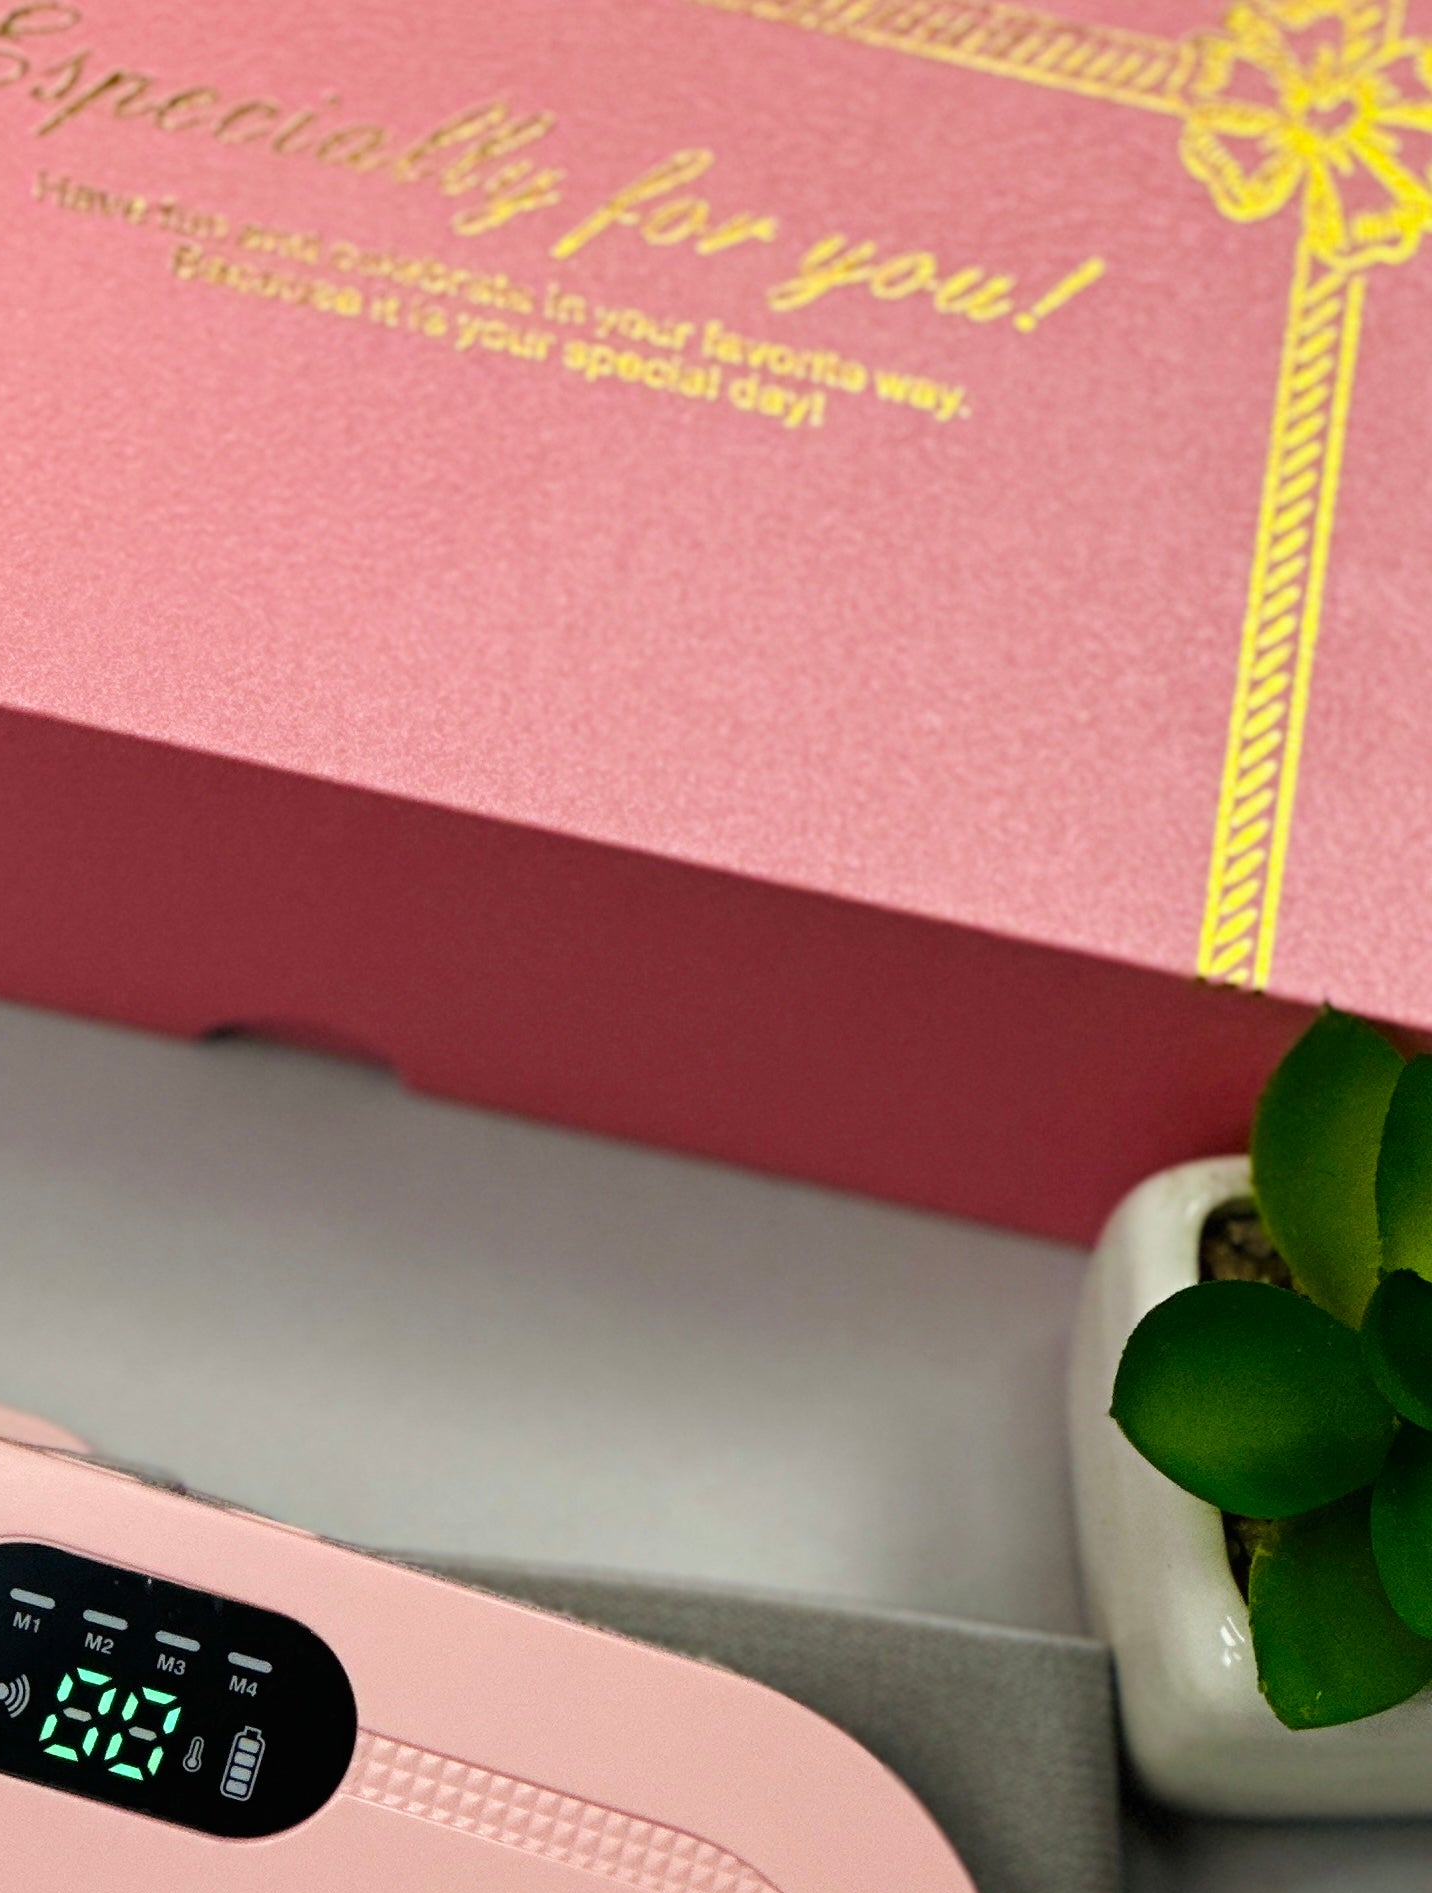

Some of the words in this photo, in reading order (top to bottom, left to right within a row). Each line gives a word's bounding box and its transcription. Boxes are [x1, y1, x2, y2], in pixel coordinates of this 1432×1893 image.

[548, 149, 778, 260] for
[770, 233, 1106, 333] you!
[369, 295, 402, 329] it
[408, 299, 449, 339] is
[453, 310, 558, 362] your
[562, 340, 723, 402] special
[728, 372, 829, 430] day!
[543, 281, 587, 326] in
[593, 303, 696, 351] your
[700, 320, 868, 394] favorite
[872, 368, 972, 423] way.
[12, 1611, 42, 1634] M1
[84, 1632, 115, 1656] M2
[156, 1653, 187, 1676] M3
[228, 1674, 259, 1697] M4
